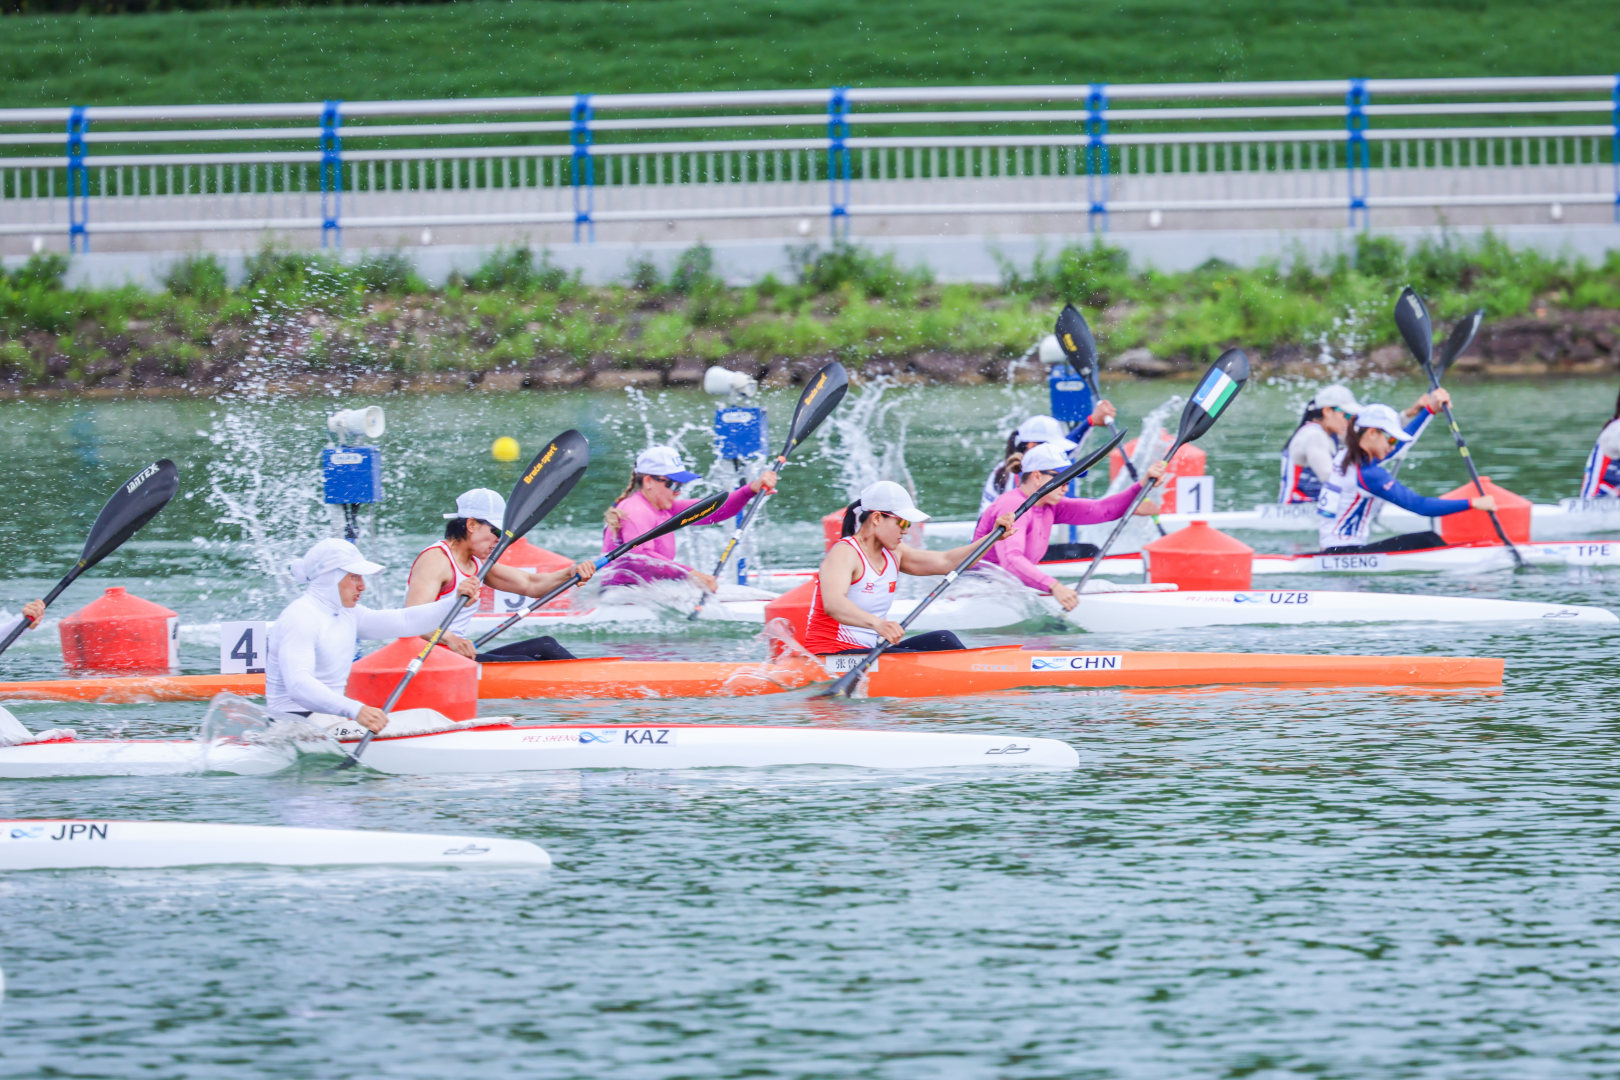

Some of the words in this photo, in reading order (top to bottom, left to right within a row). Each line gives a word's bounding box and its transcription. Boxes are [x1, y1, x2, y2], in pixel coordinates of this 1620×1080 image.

[1188, 482, 1201, 512] 1
[1320, 491, 1328, 507] 6
[1576, 544, 1611, 557] TPE
[1269, 592, 1309, 604] UZB
[230, 627, 258, 667] 4
[1070, 656, 1116, 669] CHN
[623, 729, 670, 744] KAZ
[51, 823, 108, 840] JPN
